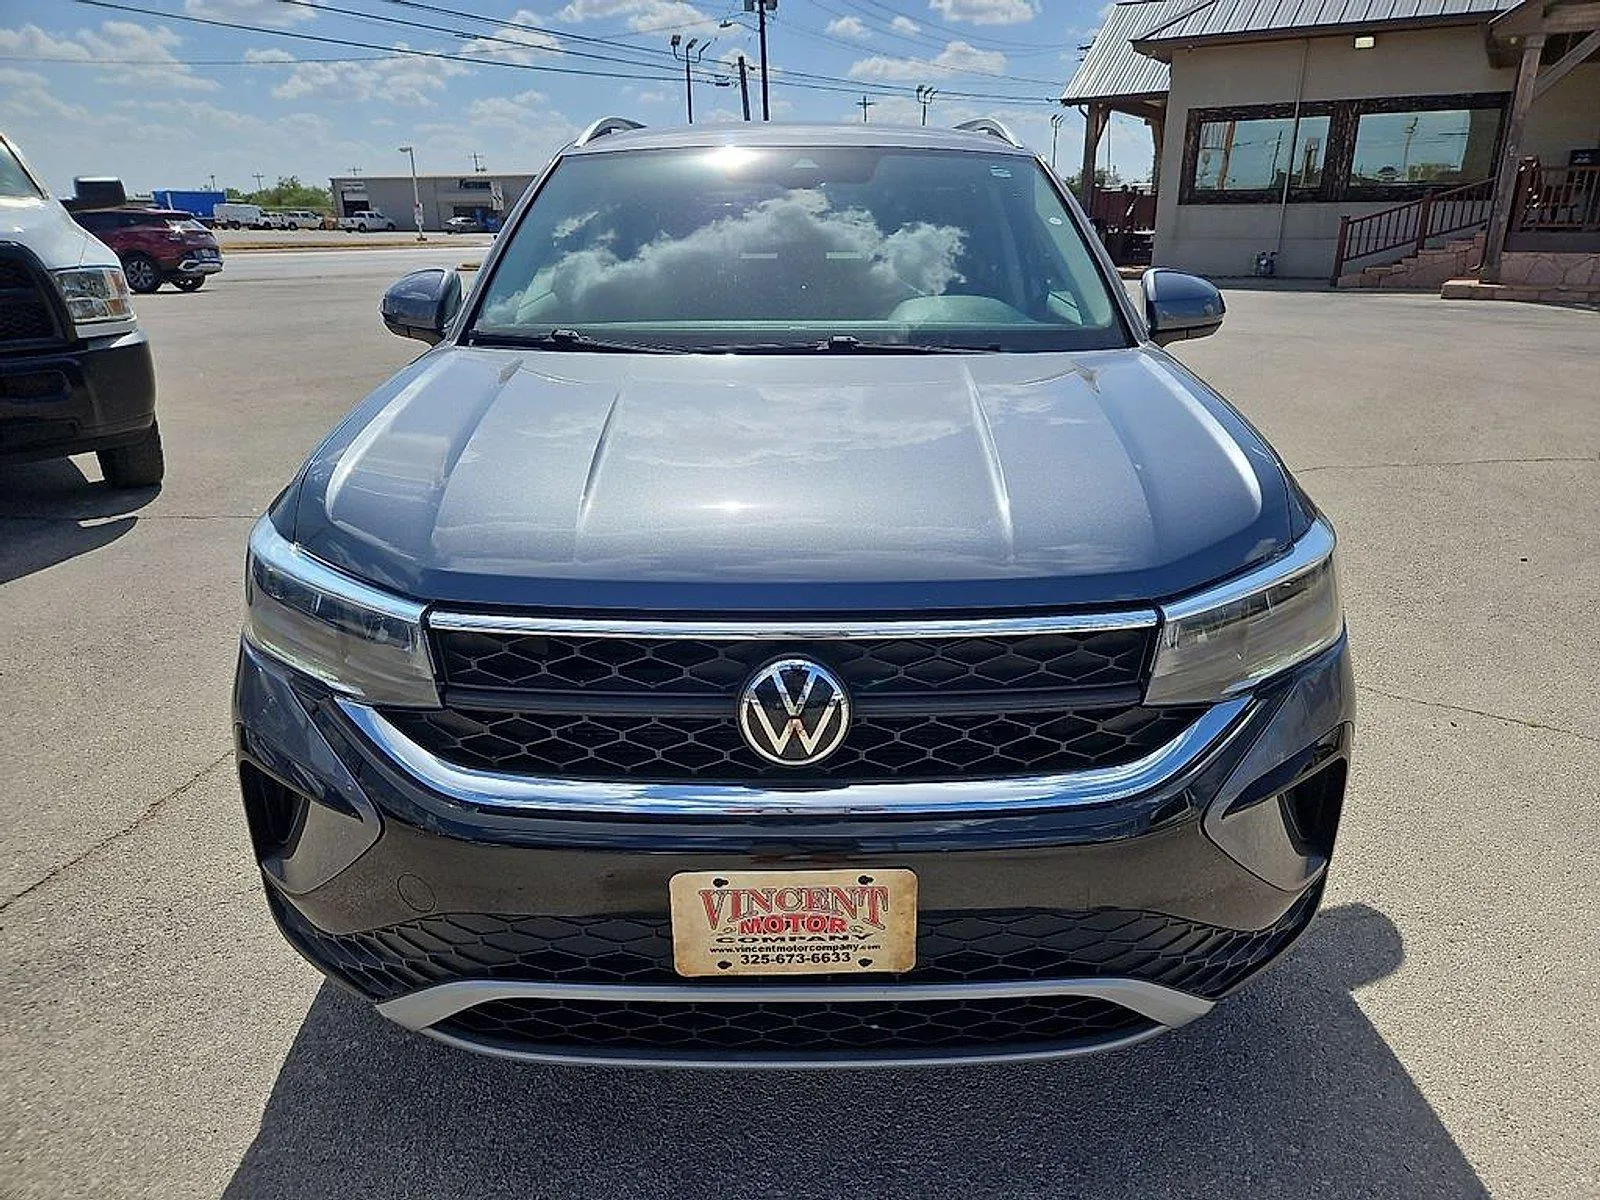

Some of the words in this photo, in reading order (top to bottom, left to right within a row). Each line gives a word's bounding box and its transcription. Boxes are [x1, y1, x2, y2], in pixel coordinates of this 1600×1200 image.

[744, 665, 843, 756] VW
[699, 886, 889, 931] VINCENT
[740, 914, 847, 935] MOTOR
[716, 933, 874, 943] COMPANY
[710, 944, 881, 954] www.vincentmotorcompany.com
[741, 952, 851, 964] 325-673-6633
